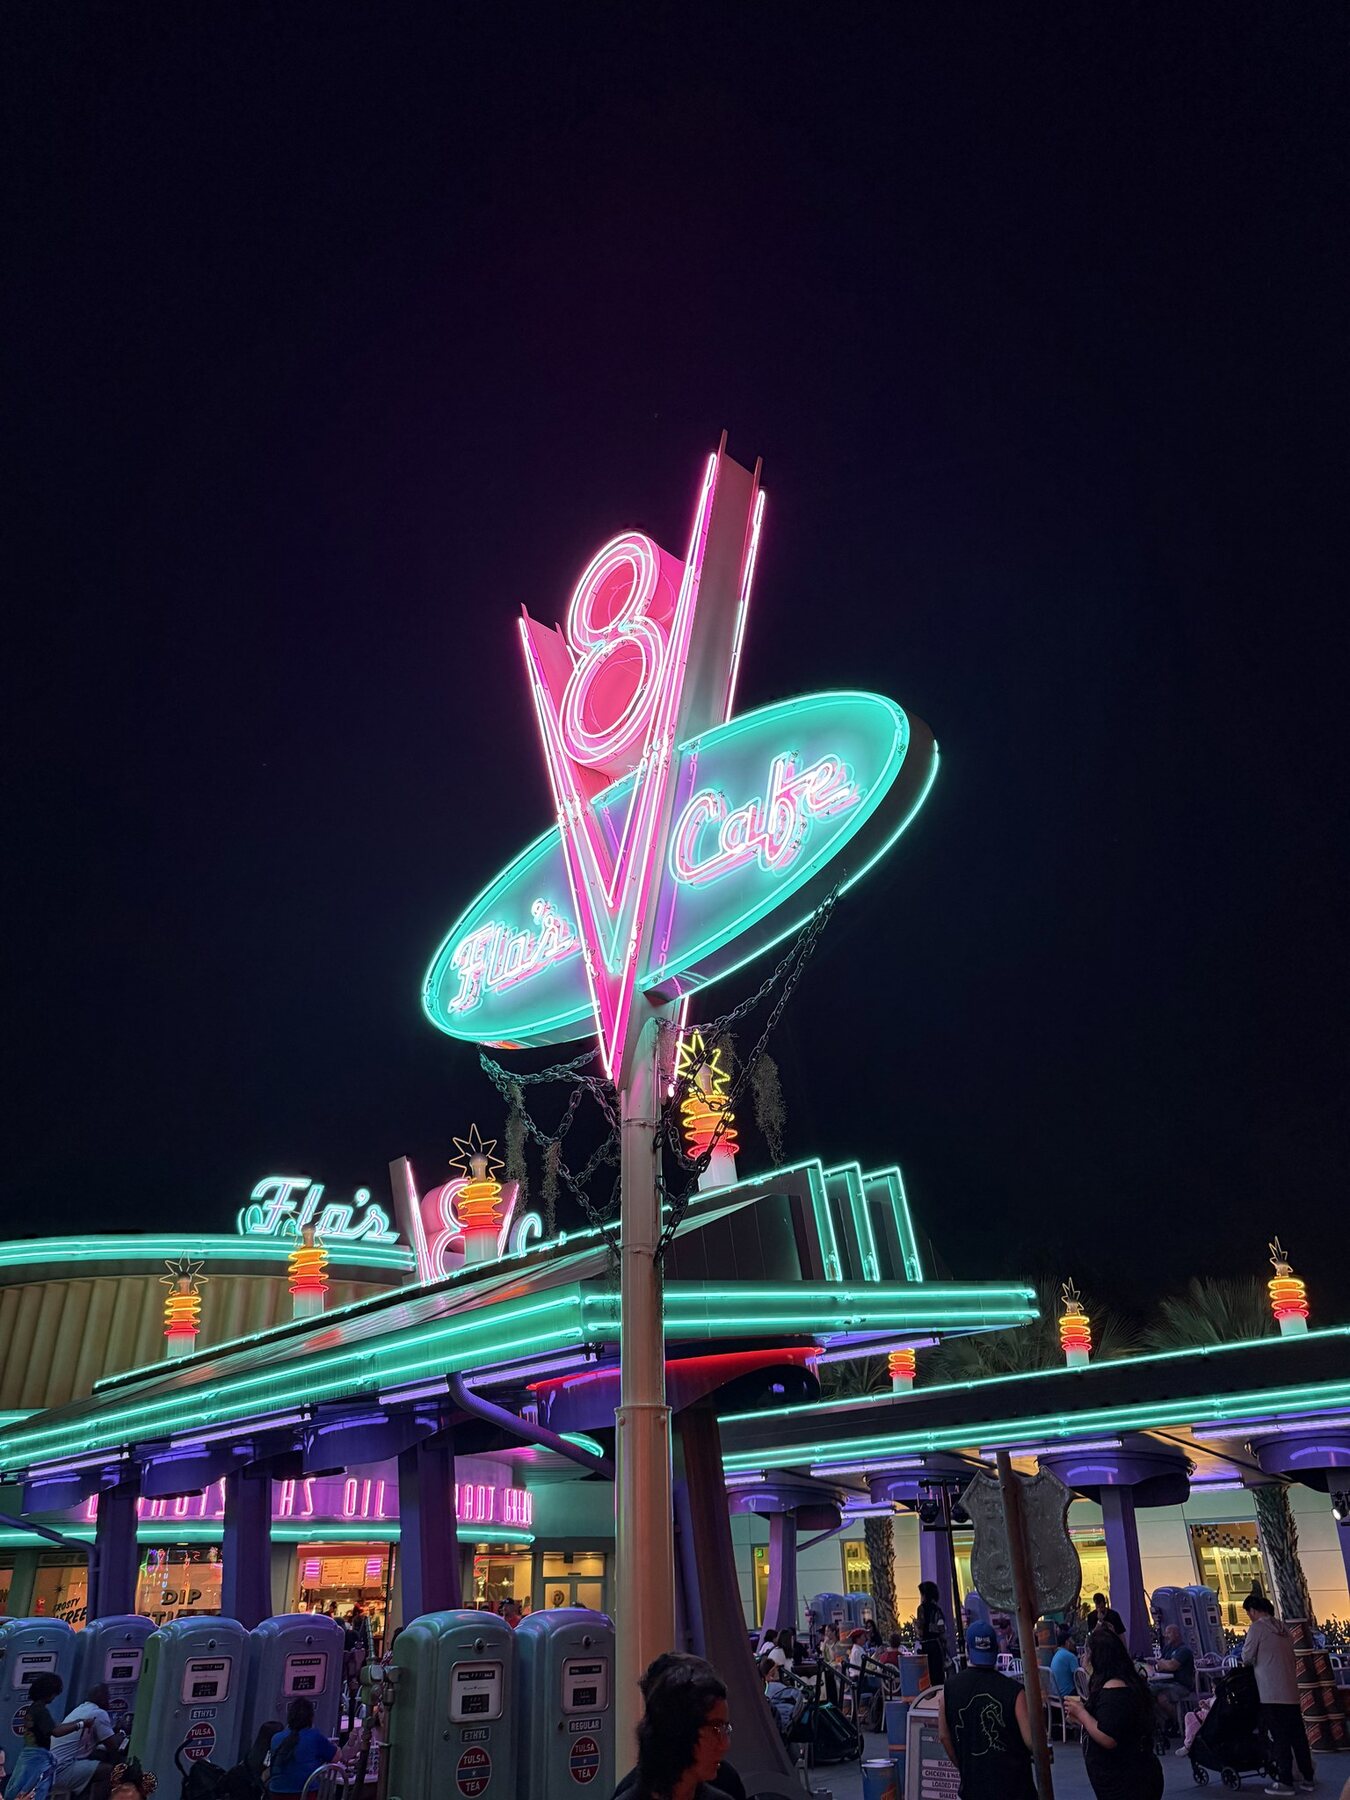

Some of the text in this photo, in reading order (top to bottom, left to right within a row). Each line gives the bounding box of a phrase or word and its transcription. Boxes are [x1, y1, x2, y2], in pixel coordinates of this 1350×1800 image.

[448, 897, 580, 1016] Flo's
[669, 750, 863, 887] Cafe
[244, 1175, 401, 1244] Flo's
[344, 1478, 386, 1517] OIL
[162, 1589, 202, 1606] DIP
[192, 1709, 215, 1719] ETHYL
[570, 1720, 600, 1731] REGULAR
[191, 1728, 211, 1737] TULSA
[463, 1730, 487, 1741] ETHYL
[191, 1749, 205, 1757] TEA
[575, 1743, 595, 1753] TULSA
[463, 1754, 486, 1765] TULSA
[577, 1769, 591, 1778] TEA
[925, 1770, 946, 1778] CHICKEN
[465, 1782, 481, 1792] TEA
